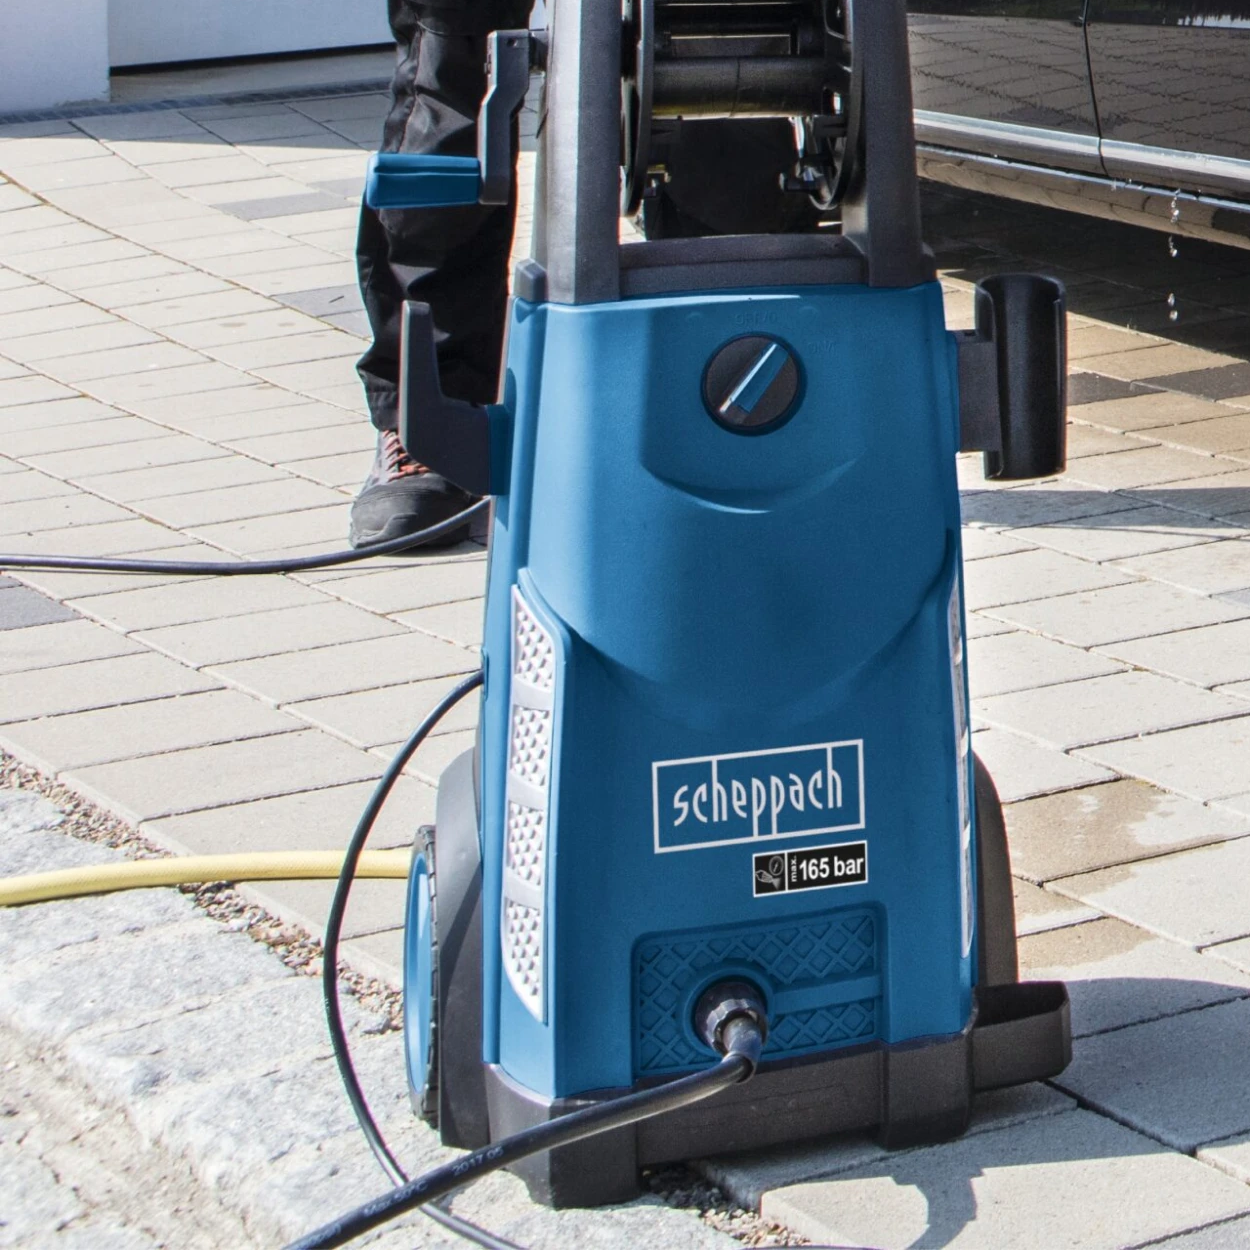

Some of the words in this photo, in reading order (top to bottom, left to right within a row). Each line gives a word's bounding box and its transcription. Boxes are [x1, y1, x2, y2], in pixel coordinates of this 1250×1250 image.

[672, 744, 843, 838] scheppach
[790, 855, 798, 883] max.
[799, 857, 830, 882] 165
[834, 855, 865, 877] bar
[451, 1153, 484, 1176] 2017
